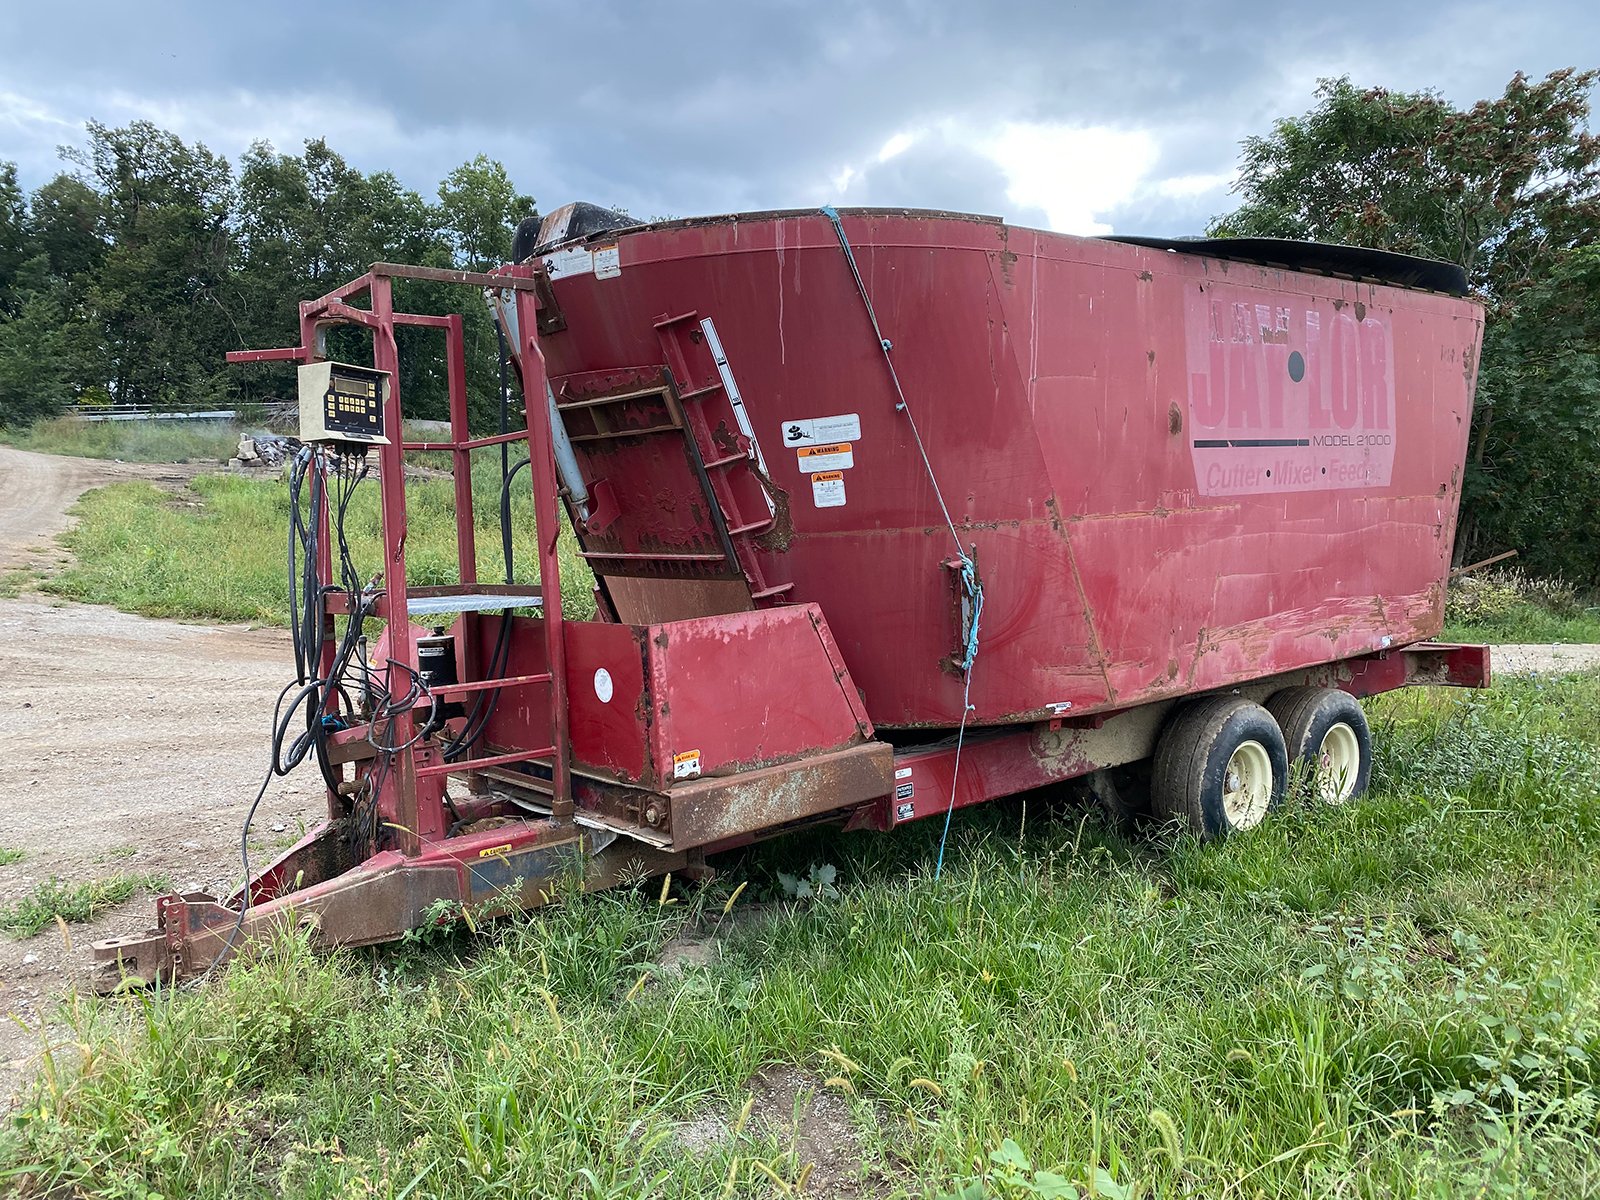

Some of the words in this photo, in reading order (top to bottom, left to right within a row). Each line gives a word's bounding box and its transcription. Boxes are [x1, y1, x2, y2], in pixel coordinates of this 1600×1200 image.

[1312, 435, 1354, 447] MODEL
[1356, 434, 1392, 447] 21000
[816, 446, 840, 454] WARNING
[1206, 461, 1263, 489] Cutter
